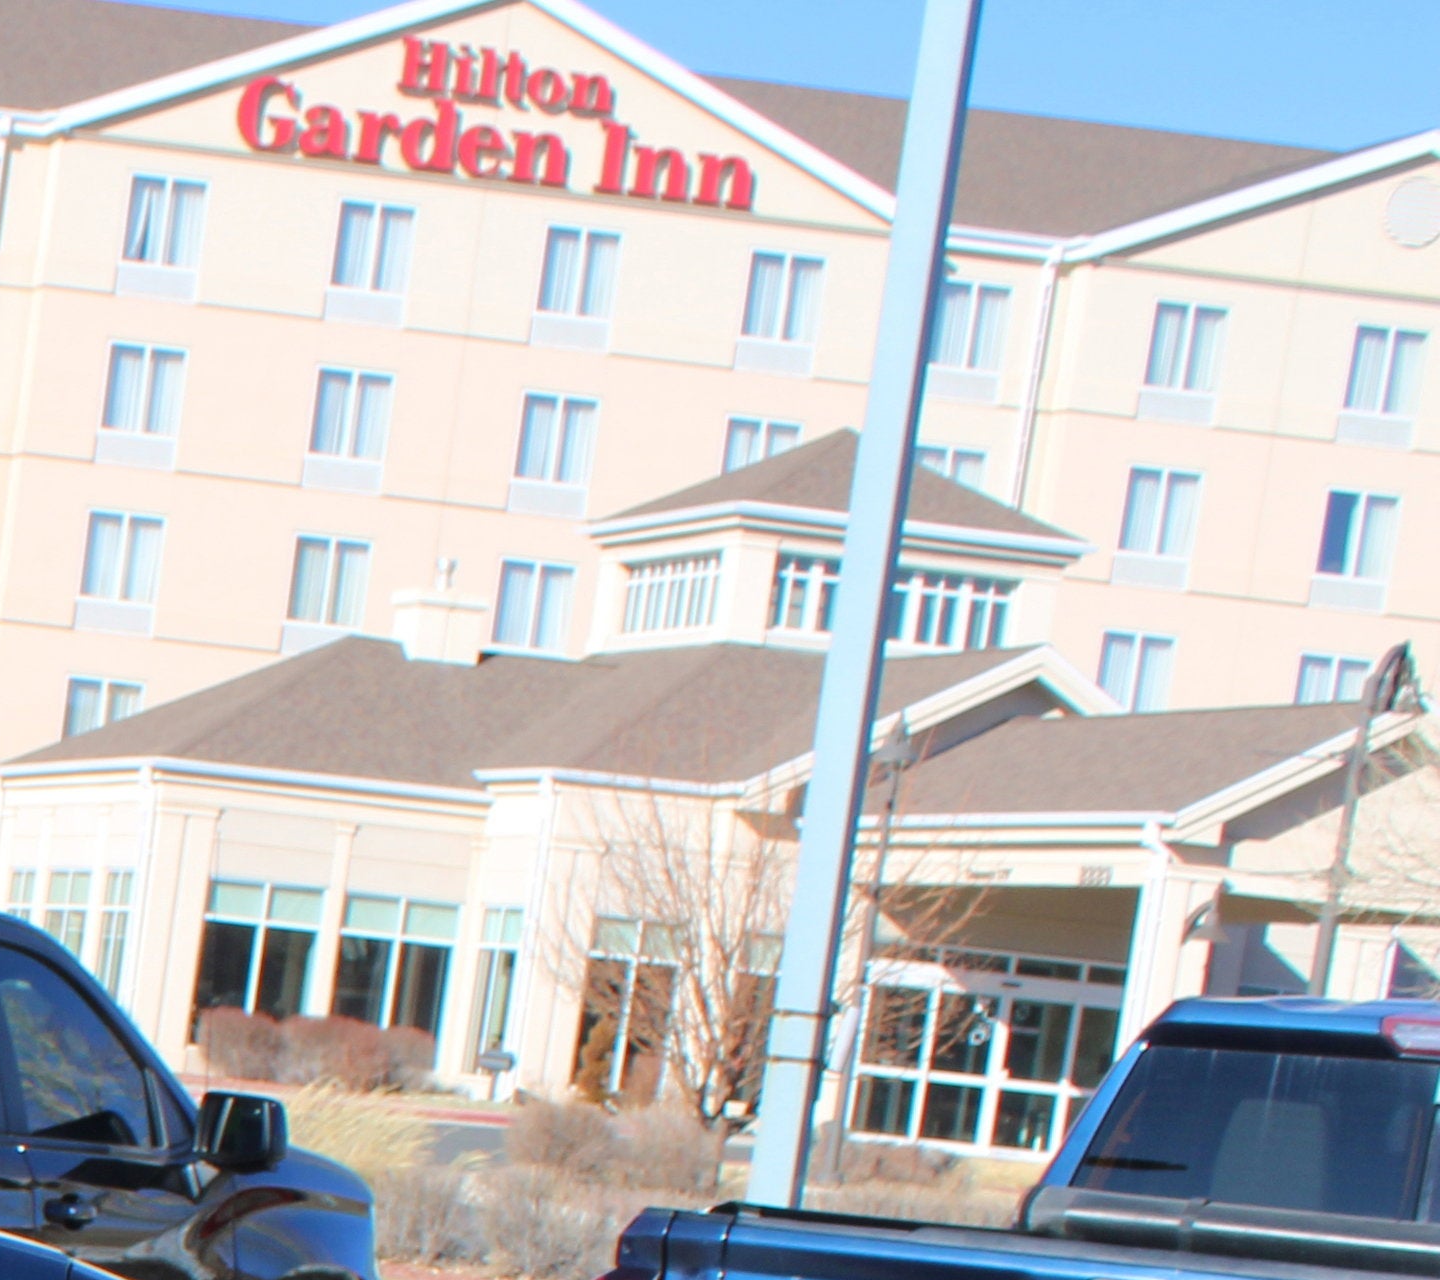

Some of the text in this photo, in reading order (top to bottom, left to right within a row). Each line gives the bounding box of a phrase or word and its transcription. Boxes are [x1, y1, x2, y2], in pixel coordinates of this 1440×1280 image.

[397, 34, 614, 114] Hilton
[236, 74, 754, 211] Garden Inn
